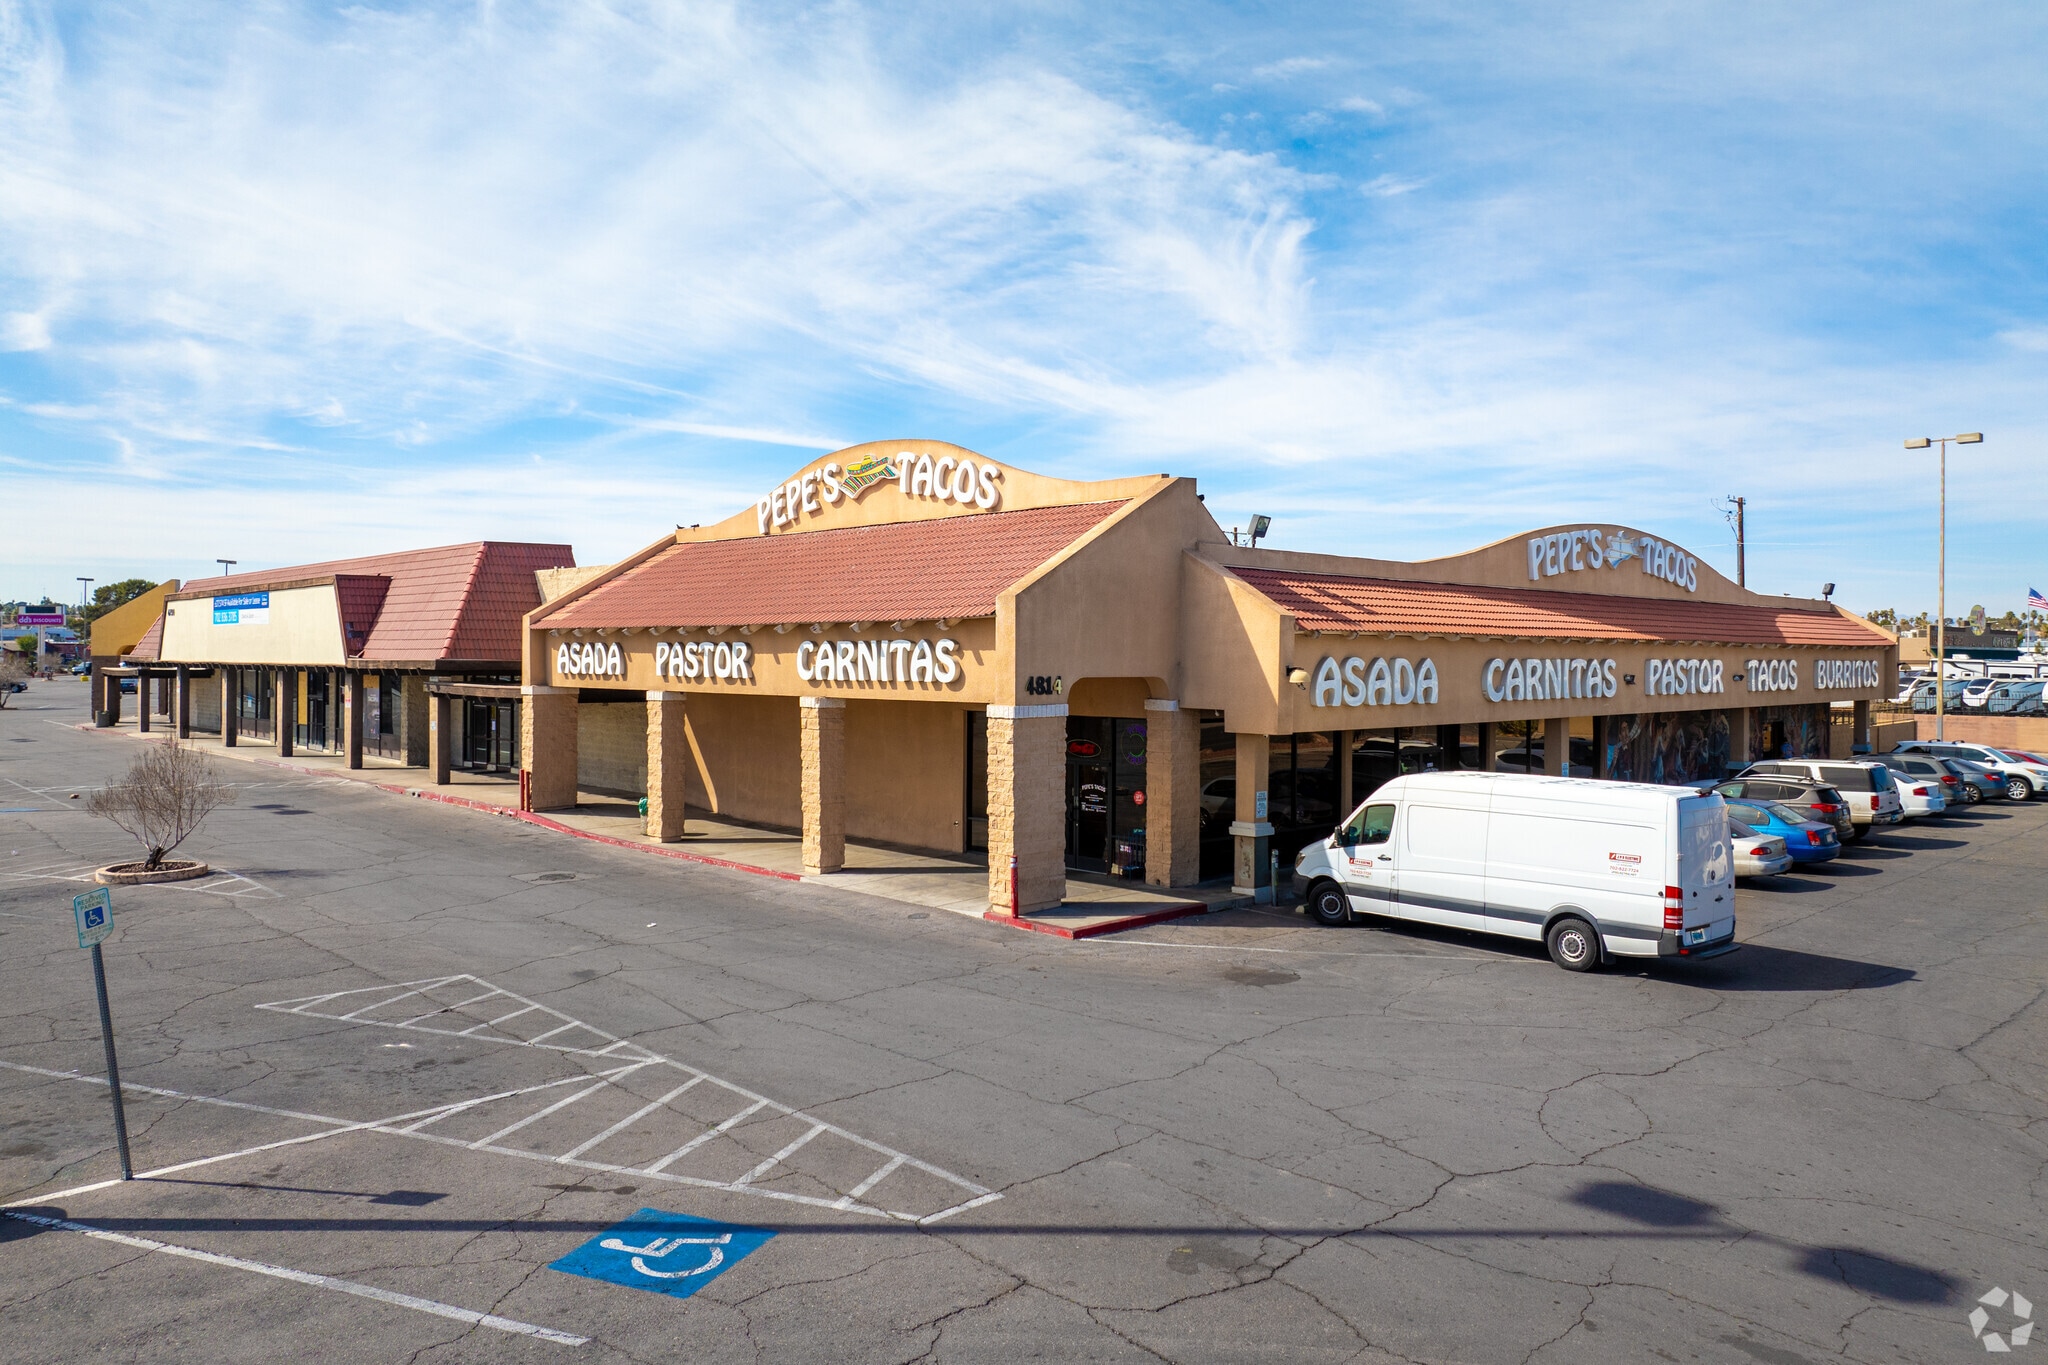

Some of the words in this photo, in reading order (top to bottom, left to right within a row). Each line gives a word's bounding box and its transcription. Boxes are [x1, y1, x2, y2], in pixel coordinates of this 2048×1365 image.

[756, 462, 842, 535] PEPE'S
[896, 451, 1001, 509] TACOS
[1528, 528, 1603, 581] PEPE'S
[1639, 536, 1697, 593] TACOS
[556, 642, 624, 676] ASADA
[655, 641, 751, 679] PASTOR
[796, 638, 960, 684] CARNITAS
[1311, 656, 1439, 707] ASADA
[1482, 658, 1617, 703] CARNITAS
[1645, 658, 1724, 696] PASTOR
[1745, 659, 1798, 692] TACOS
[1815, 659, 1879, 690] BURRITOS
[1025, 675, 1062, 695] 4814
[77, 893, 106, 906] RESERVED
[80, 900, 105, 912] PARKING
